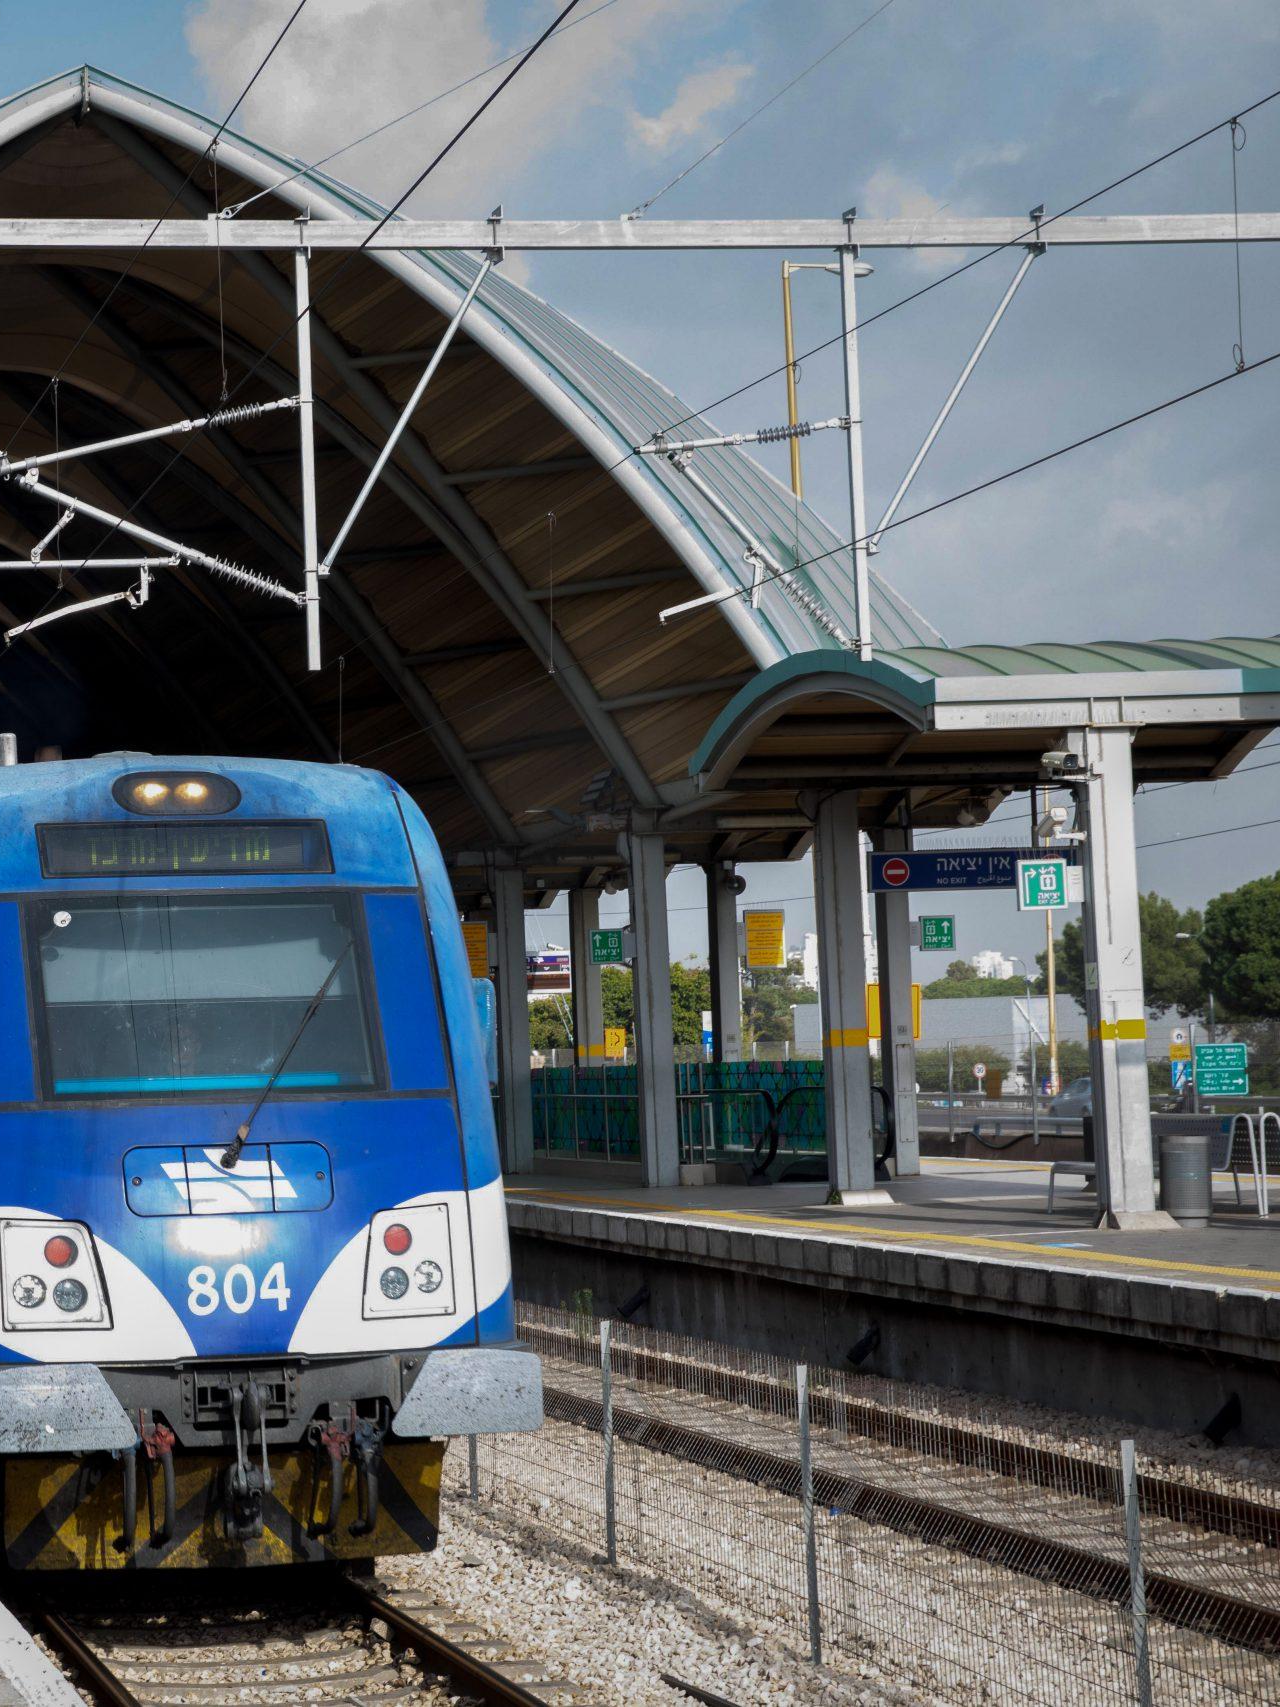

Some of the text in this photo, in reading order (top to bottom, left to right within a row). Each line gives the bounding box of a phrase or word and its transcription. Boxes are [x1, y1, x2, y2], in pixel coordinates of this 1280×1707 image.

[937, 856, 1012, 873] אין יציאה
[1037, 892, 1060, 901] יציאה
[925, 935, 951, 943] יציאה
[594, 948, 620, 956] יציאה
[187, 1262, 291, 1317] 804
